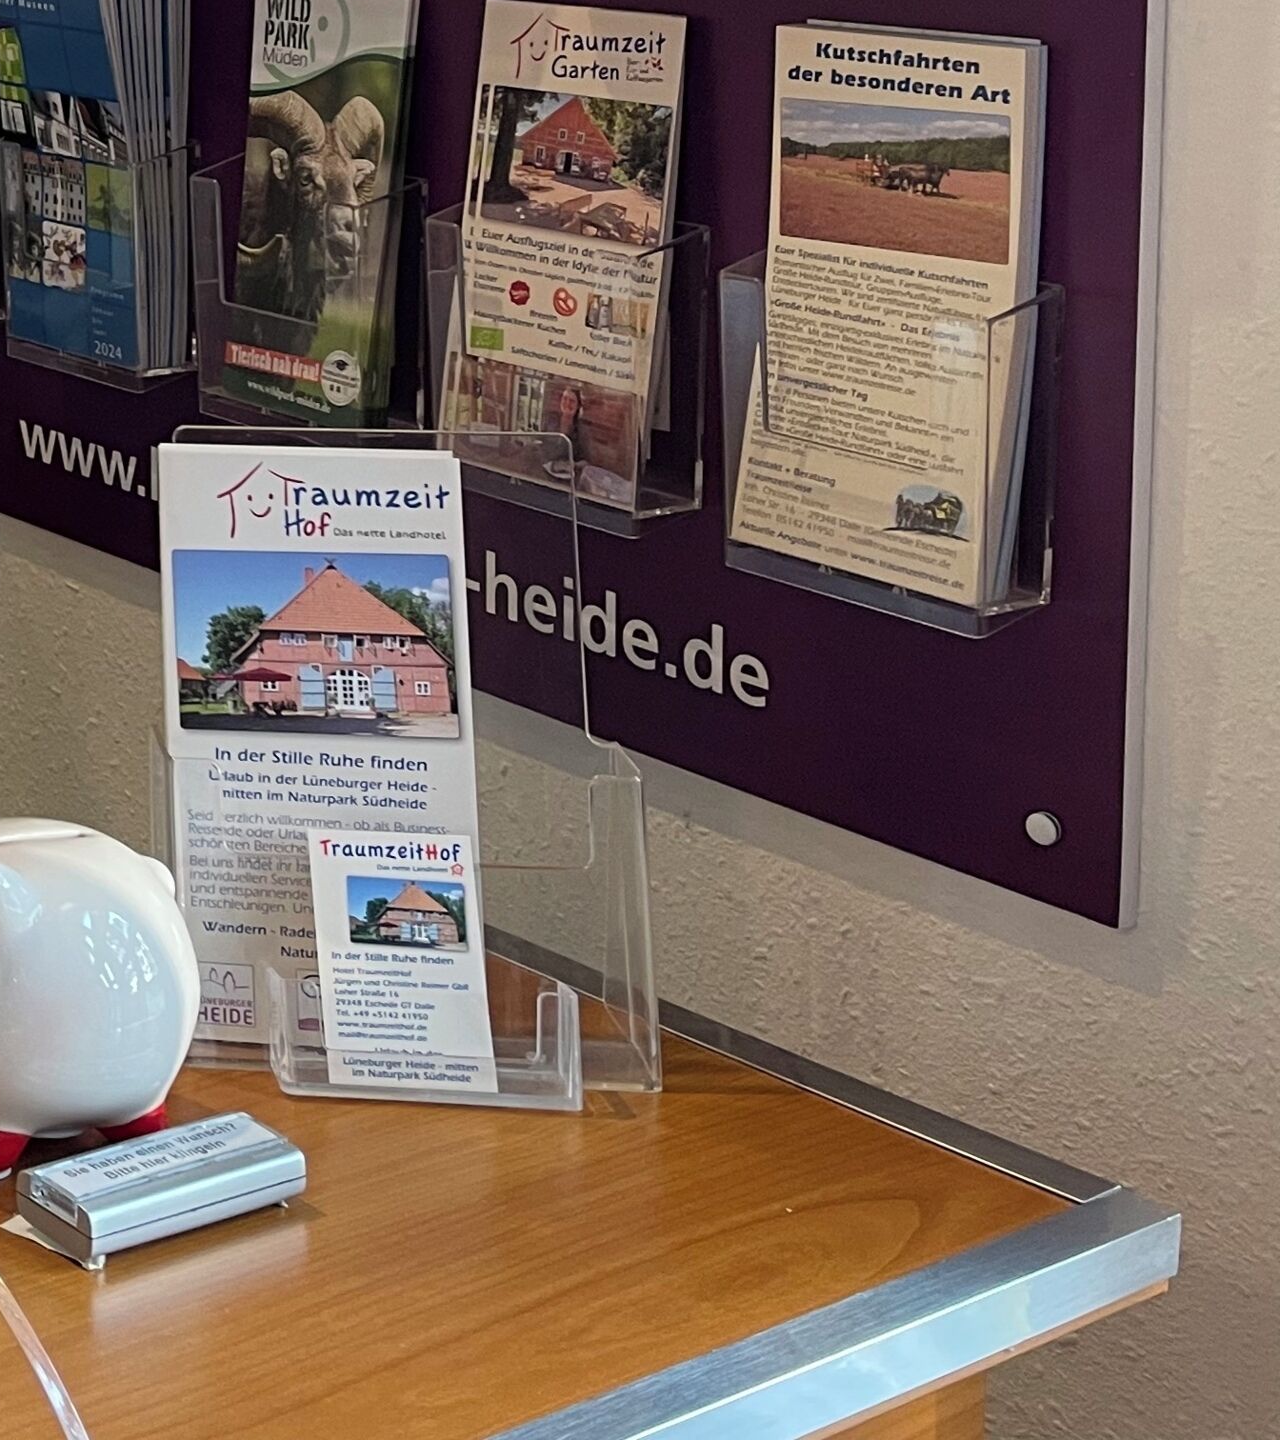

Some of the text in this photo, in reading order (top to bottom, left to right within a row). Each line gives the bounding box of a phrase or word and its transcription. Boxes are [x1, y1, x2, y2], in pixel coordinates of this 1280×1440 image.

[264, 20, 310, 50] PARK
[546, 19, 667, 54] Traumzeit
[262, 45, 309, 68] Müden
[551, 54, 620, 81] Garten
[816, 42, 980, 75] Kutschfahrten
[788, 65, 1011, 104] der besonderen Art
[568, 243, 579, 255] in
[551, 255, 569, 269] der
[602, 266, 621, 279] der
[94, 340, 123, 359] 2024
[231, 345, 272, 372] Tierisch
[268, 469, 450, 509] Traumzeit
[284, 509, 446, 540] Hof Das nette Landhotel
[215, 747, 428, 772] In der Stille Ruhe finden
[258, 772, 428, 793] in der Lüneburger Heide
[267, 789, 428, 810] im Naturpark Südheide
[320, 839, 462, 862] TraumzeitHof
[202, 921, 267, 935] Wandern
[331, 952, 454, 965] In der Stille Ruhe finden
[343, 1057, 479, 1072] Lüneburger Heide mitten
[352, 1068, 472, 1083] im Naturpark Südheide
[63, 1164, 90, 1179] Sie
[91, 1151, 135, 1173] haben
[175, 1122, 238, 1151] Wunsch?
[103, 1140, 226, 1181] Bitte hier klingeln
